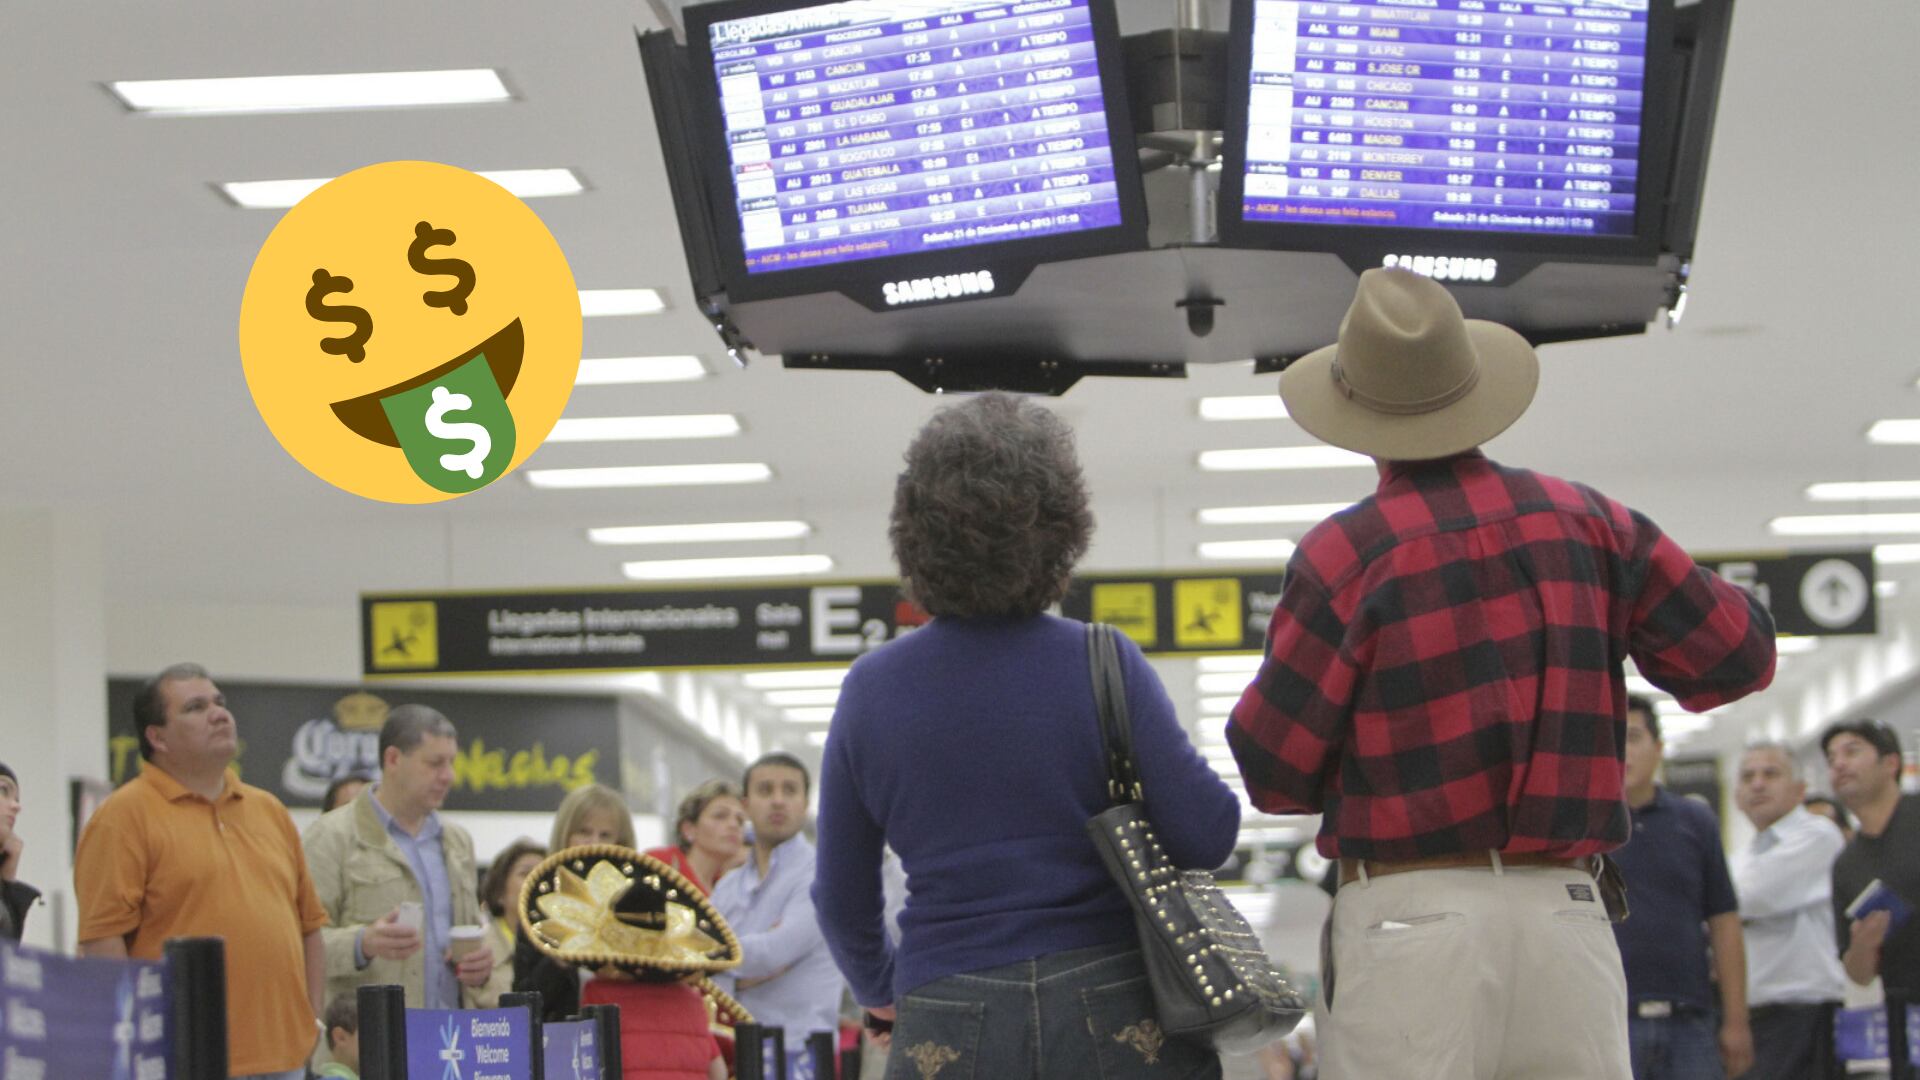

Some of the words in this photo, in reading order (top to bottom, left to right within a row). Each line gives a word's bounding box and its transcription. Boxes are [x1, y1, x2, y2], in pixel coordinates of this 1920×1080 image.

[1499, 4, 1521, 12] SALA
[775, 40, 802, 50] VUELO
[826, 28, 882, 42] PROCEDENCIA
[941, 15, 962, 24] SALA
[824, 44, 863, 58] CANCUN
[1029, 13, 1063, 27] TIEMPO
[1585, 22, 1620, 33] TIEMPO
[1370, 28, 1399, 37] MIAMI
[1584, 40, 1619, 51] TIEMPO
[826, 62, 865, 76] CANCUN
[1032, 31, 1066, 45] TIEMPO
[1369, 46, 1381, 55] LA
[1384, 46, 1404, 56] PAZ
[1583, 58, 1618, 69] TIEMPO
[828, 77, 879, 93] MAZATLAN
[1034, 49, 1069, 63] TIEMPO
[1581, 76, 1617, 86] TIEMPO
[832, 93, 895, 111] GUADALAJAR
[1037, 67, 1072, 81] TIEMPO
[1367, 81, 1412, 92] CHICAGO
[1581, 93, 1616, 104] TIEMPO
[860, 112, 886, 124] CABO
[1039, 85, 1075, 98] TIEMPO
[1366, 99, 1408, 110] CANCUN
[1579, 111, 1615, 121] TIEMPO
[837, 136, 849, 146] LA
[852, 130, 890, 145] HABANA
[1042, 102, 1078, 116] TIEMPO
[1045, 120, 1080, 134] TIEMPO
[1364, 117, 1413, 128] HOUSTON
[1578, 129, 1613, 139] TIEMPO
[1364, 135, 1402, 145] MADRID
[1578, 146, 1613, 156] TIEMPO
[843, 164, 900, 181] GUATEMALA
[1048, 138, 1083, 152] TIEMPO
[1362, 151, 1424, 163] MONTERREY
[1576, 163, 1612, 174] TIEMPO
[845, 186, 864, 198] LAS
[867, 181, 897, 194] VEGAS
[1050, 156, 1086, 169] TIEMPO
[1362, 170, 1401, 180] DENVER
[1575, 181, 1610, 191] TIEMPO
[848, 201, 888, 215] TIJUANA
[1053, 173, 1088, 187] TIEMPO
[1361, 188, 1400, 198] DALLAS
[1574, 199, 1609, 209] TIEMPO
[850, 221, 871, 232] NEW
[874, 217, 900, 230] YORK
[1056, 191, 1091, 205] TIEMPO
[1491, 215, 1531, 224] Diciembre
[978, 222, 1018, 235] Diciembre
[882, 269, 995, 305] SAMSUNG
[488, 606, 581, 634] Llegadas
[584, 604, 739, 632] Internacionales
[471, 1017, 510, 1038] Bienvenido
[476, 1045, 510, 1064] Welcome
